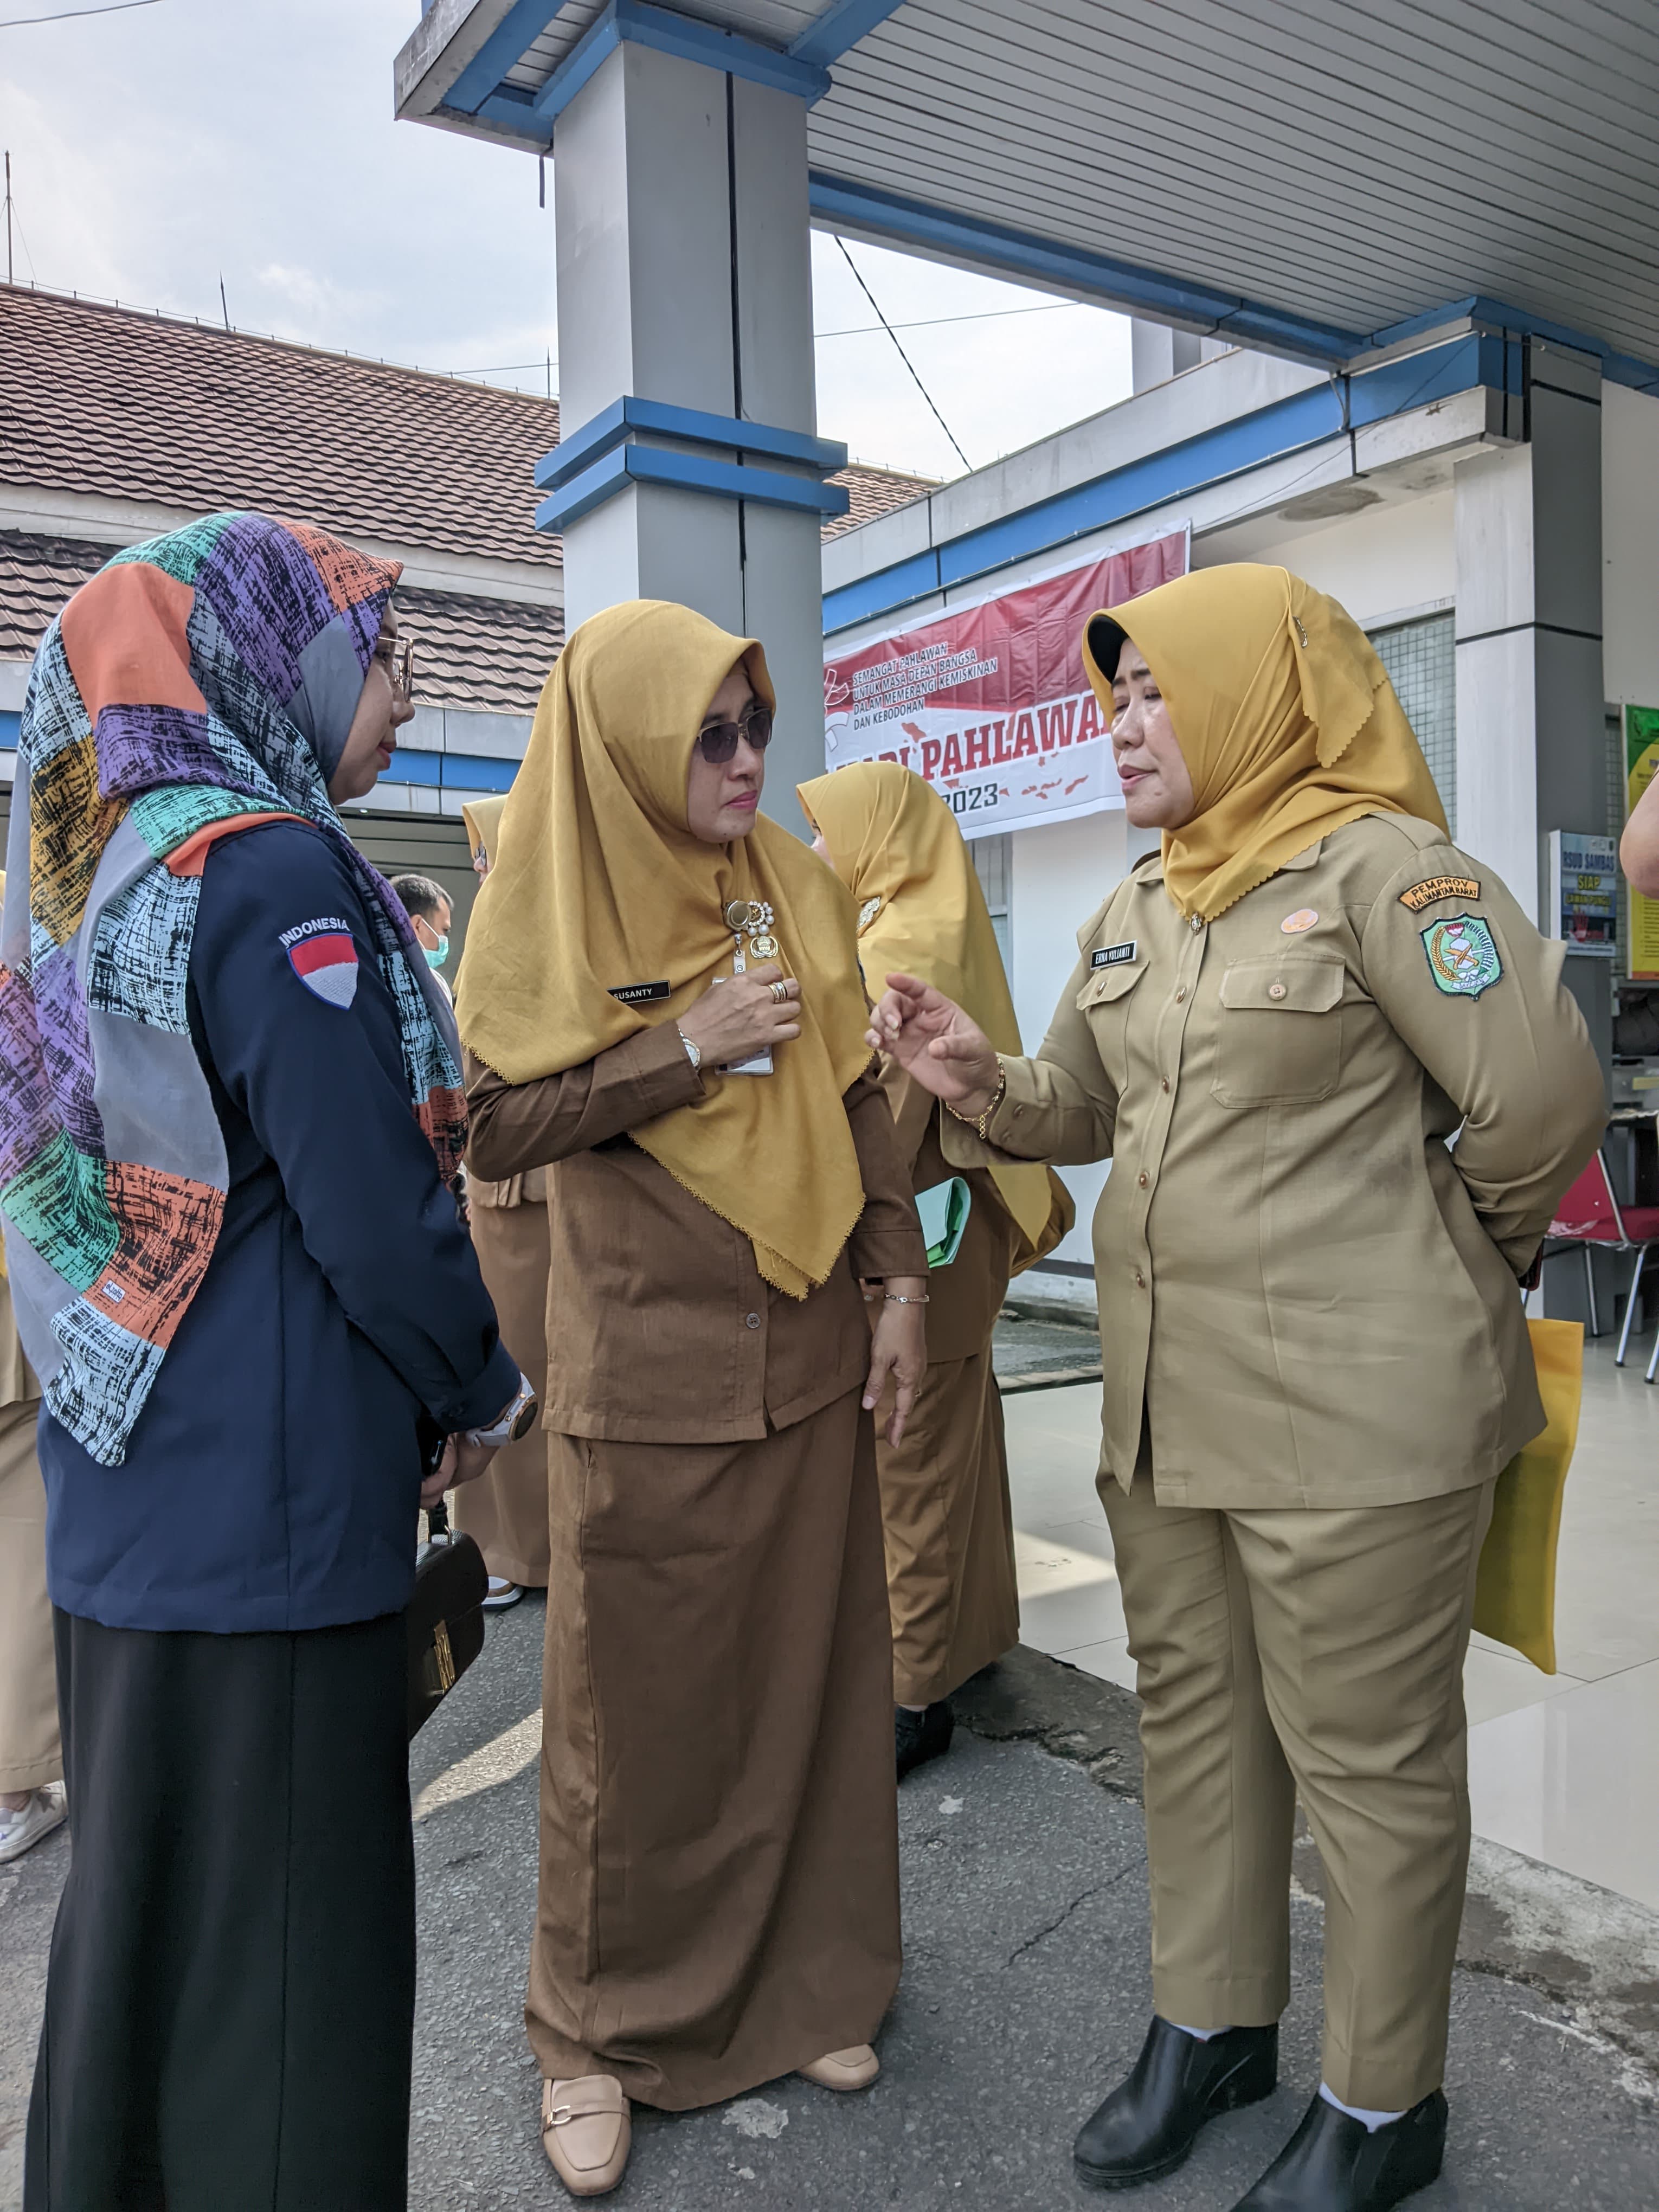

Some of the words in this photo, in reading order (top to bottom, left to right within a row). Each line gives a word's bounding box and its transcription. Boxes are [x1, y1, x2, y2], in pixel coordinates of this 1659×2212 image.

[854, 660, 897, 685] SEMANGAT
[900, 643, 947, 669] PAHLAWAN
[854, 683, 881, 700] UNTUK
[883, 673, 906, 691] MASA
[909, 664, 937, 681] DEPAN
[940, 650, 976, 673] BANGSA
[854, 697, 883, 715] DALAM
[884, 681, 937, 706] MEMERANGI
[940, 659, 997, 688] KEMISKINAN
[854, 716, 870, 730] DAN
[873, 698, 924, 724] KEBODOHAN
[921, 695, 1110, 781] PAHLAWA
[1563, 851, 1583, 869] RSUD
[1585, 853, 1615, 871] SAMBAS
[1411, 878, 1468, 898] PEMPROV
[1455, 887, 1476, 896] BARAT
[1578, 874, 1600, 890] SIAP
[279, 917, 350, 949] INDONESIA
[1095, 951, 1108, 964] ERNA
[1109, 946, 1130, 961] YULIANTI
[614, 988, 652, 999] SUSANTY
